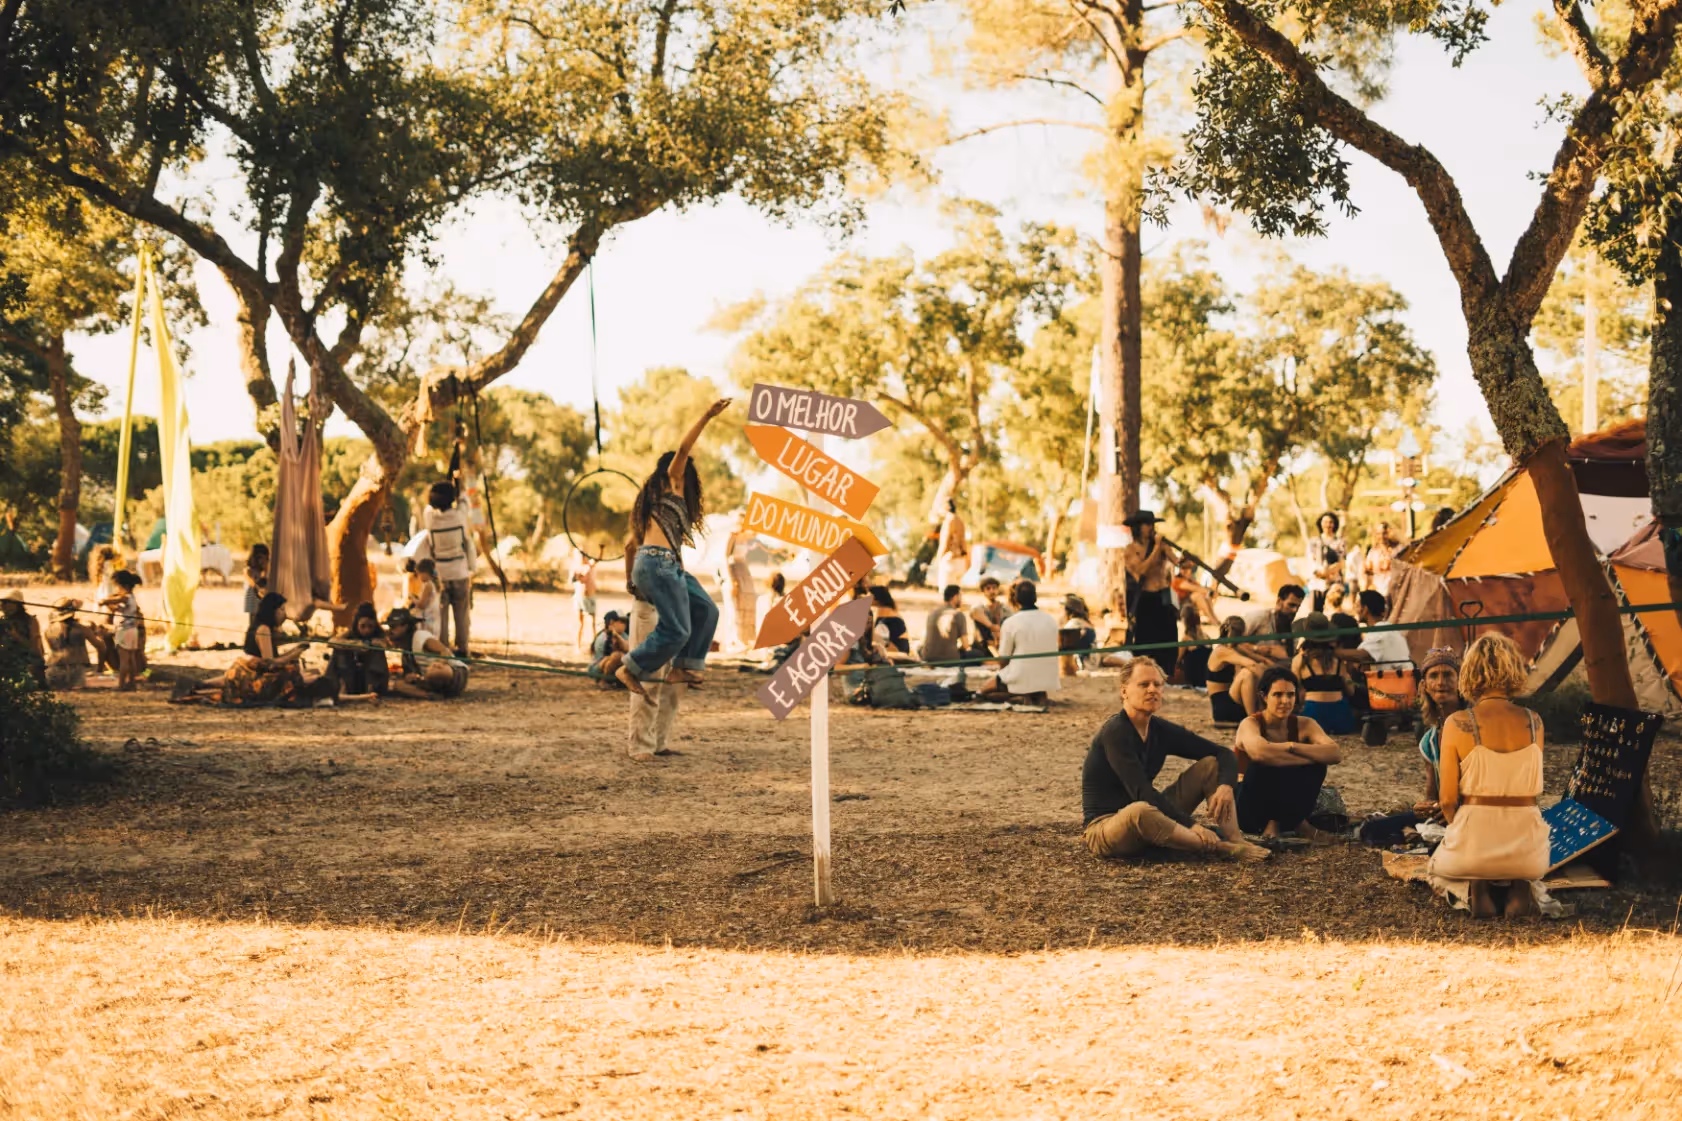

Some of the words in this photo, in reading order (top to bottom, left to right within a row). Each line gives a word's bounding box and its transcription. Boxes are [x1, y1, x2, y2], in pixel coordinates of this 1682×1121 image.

[756, 389, 772, 420] O
[775, 392, 857, 435] MELHOR
[777, 437, 854, 505] LUGAR
[748, 498, 777, 530] DO
[803, 559, 851, 615] AQUI
[767, 680, 794, 709] E
[786, 620, 856, 694] AGORA
